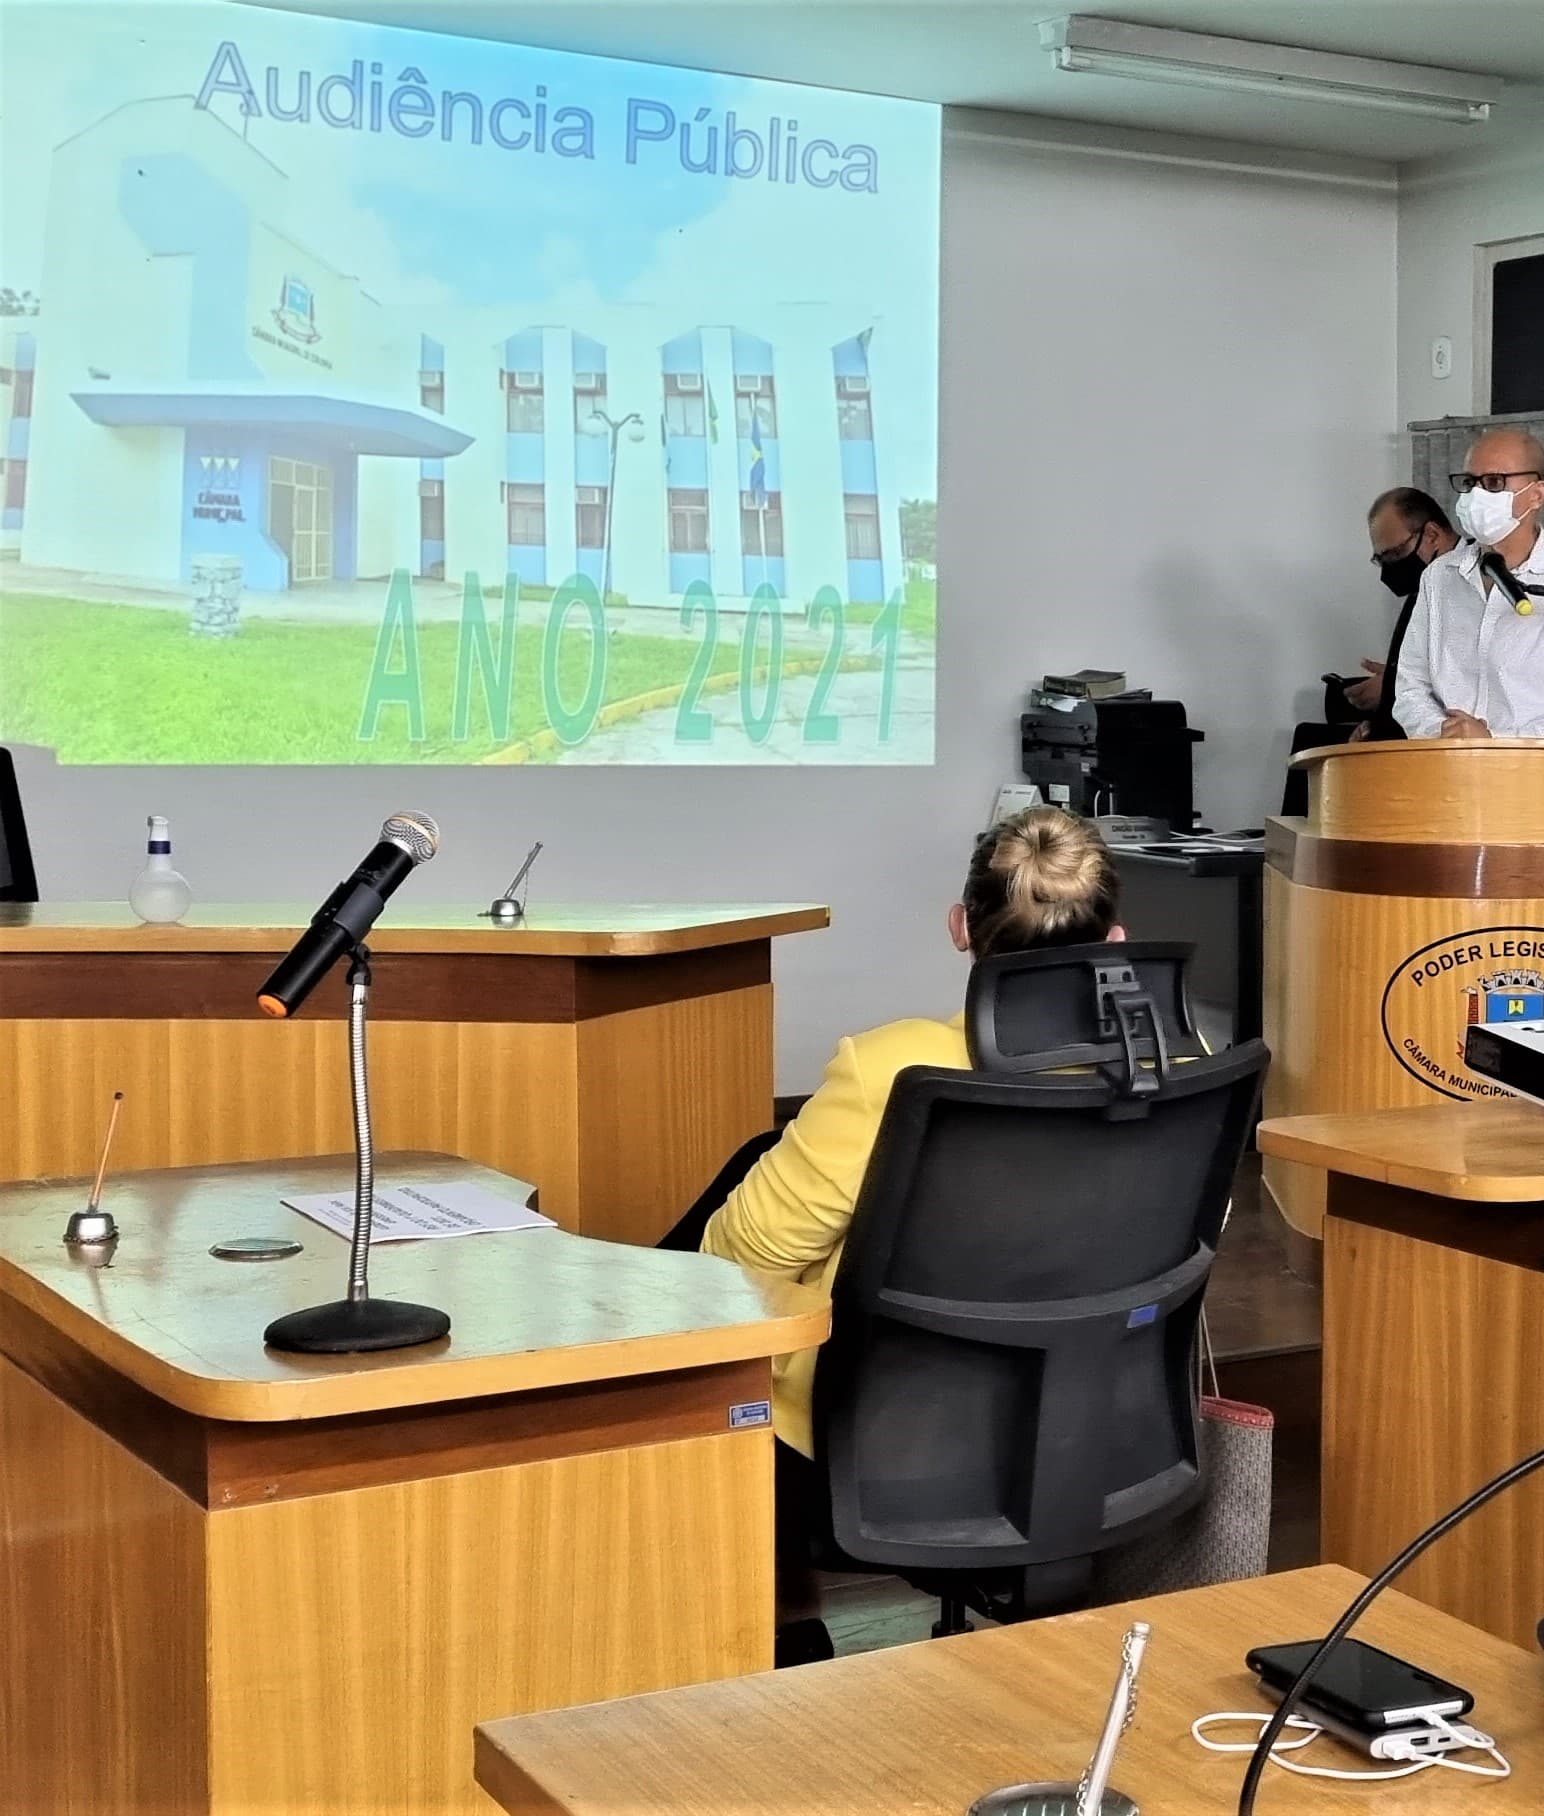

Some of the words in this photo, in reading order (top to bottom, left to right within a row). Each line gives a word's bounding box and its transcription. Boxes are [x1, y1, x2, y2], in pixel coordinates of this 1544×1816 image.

[197, 41, 596, 160] Audiência
[625, 97, 879, 194] Pública
[356, 567, 608, 746] ANO
[674, 579, 904, 747] 2021
[1411, 945, 1483, 987] PODER
[1403, 1038, 1446, 1081] CÂMARA
